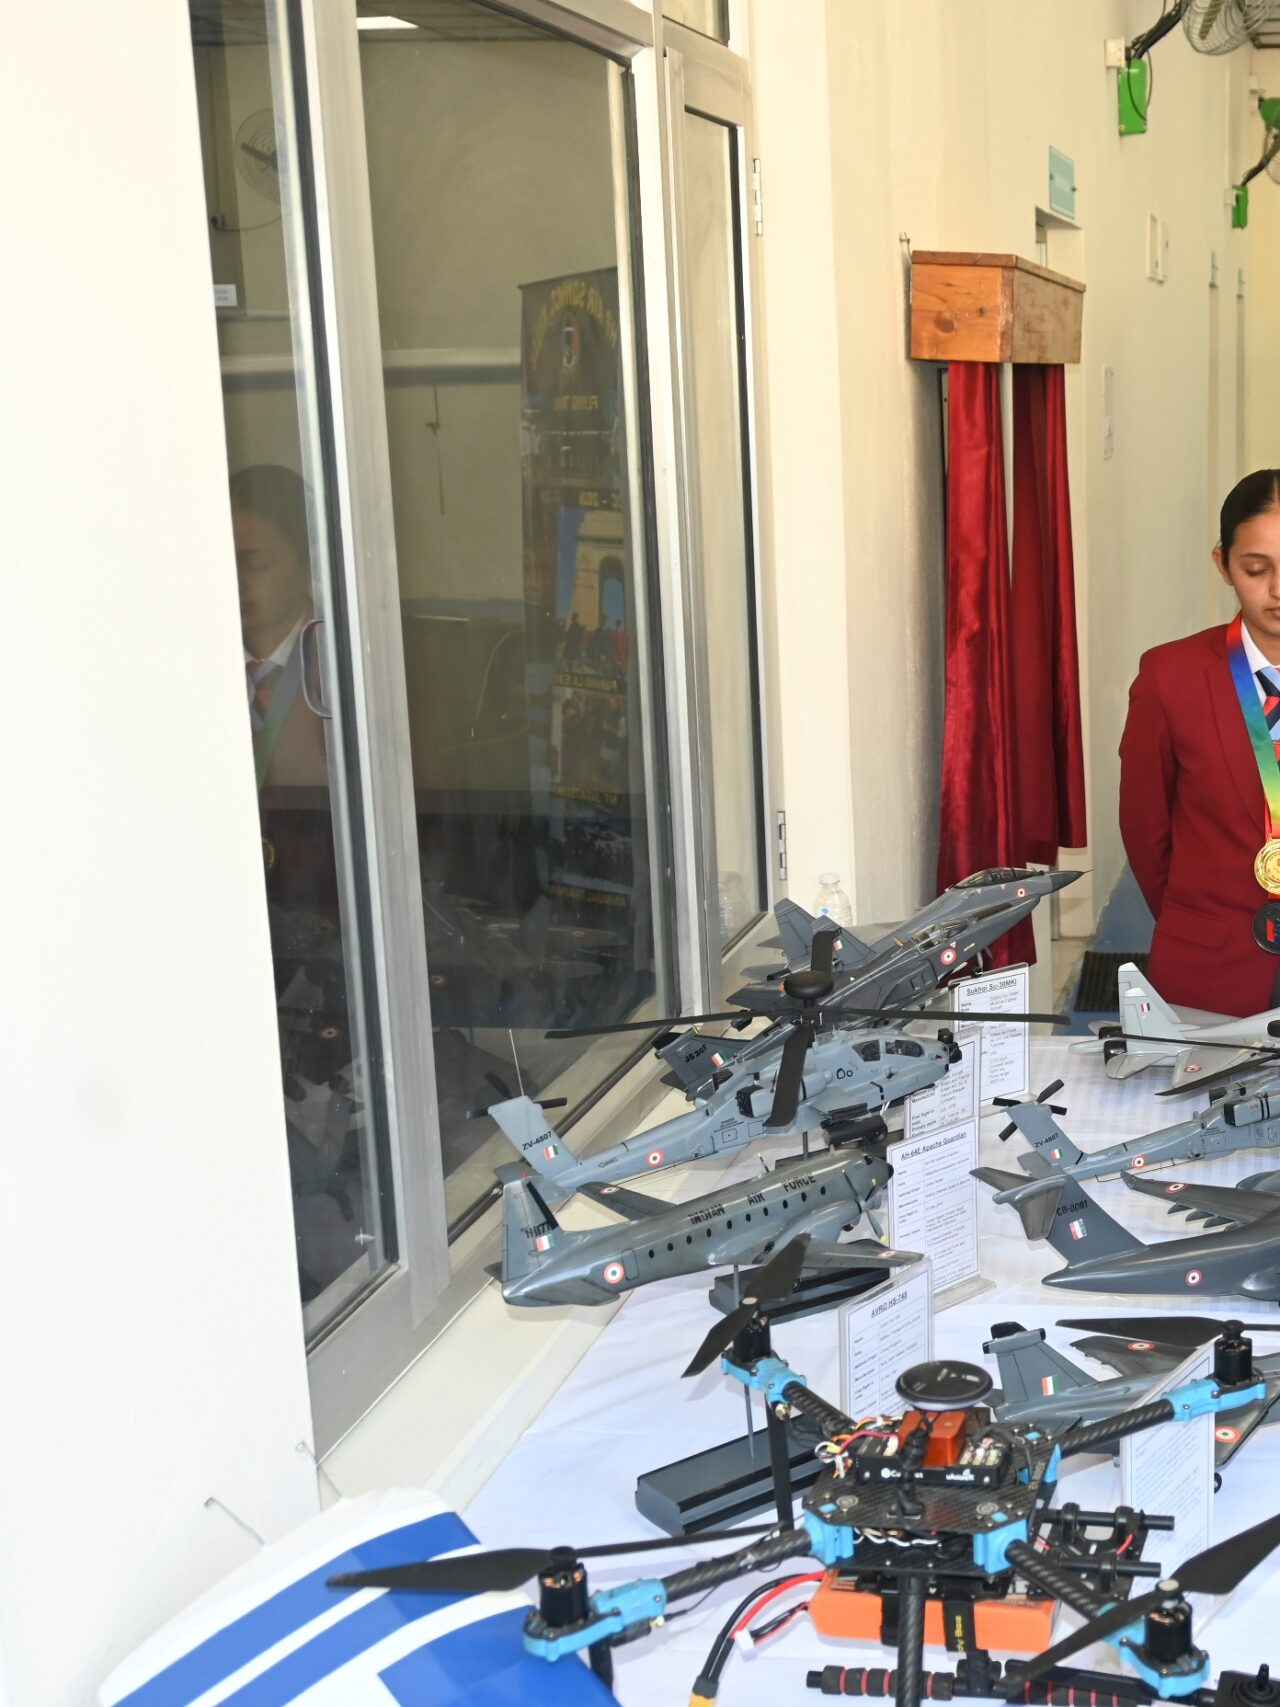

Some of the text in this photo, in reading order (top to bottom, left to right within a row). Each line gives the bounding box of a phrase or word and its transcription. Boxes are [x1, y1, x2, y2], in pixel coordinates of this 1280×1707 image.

[966, 985, 988, 995] Sukhoi
[688, 1174, 816, 1225] INDIAN AIR FORCE
[871, 1302, 888, 1318] AVRO
